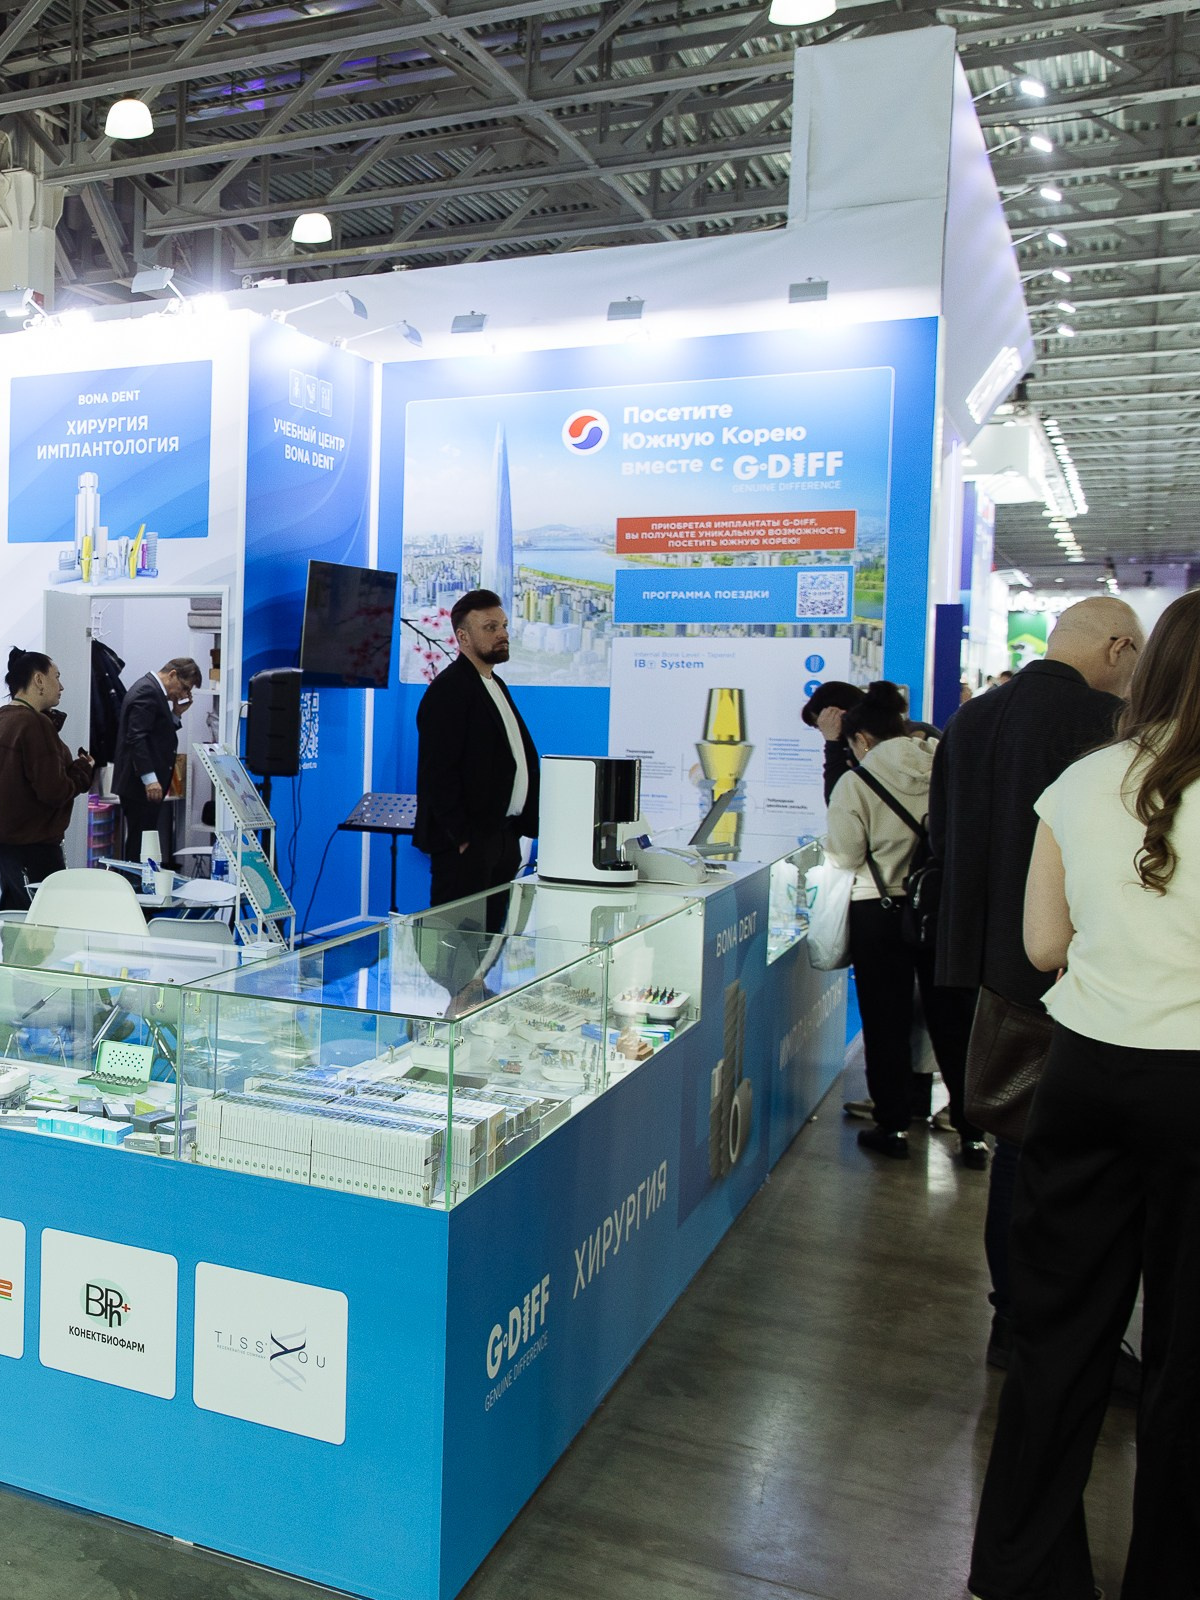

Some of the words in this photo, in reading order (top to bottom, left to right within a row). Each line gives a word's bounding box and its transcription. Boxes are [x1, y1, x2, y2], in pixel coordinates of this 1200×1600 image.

[78, 393, 109, 405] BONA
[112, 390, 140, 403] DENT
[623, 403, 733, 424] Посетите
[66, 415, 148, 436] ХИРУРГИЯ
[273, 417, 317, 444] УЧЕБНЫЙ
[318, 431, 345, 452] ЦЕНТР
[37, 436, 179, 460] ИМПЛАНТОЛОГИЯ
[622, 431, 715, 451] Южную
[722, 426, 807, 447] Корею
[284, 444, 311, 465] BONA
[312, 452, 335, 471] DENT
[621, 458, 703, 476] вместе
[710, 457, 724, 472] с
[732, 483, 776, 494] GENUINE
[778, 480, 842, 492] DIFFERENCE
[625, 532, 639, 540] ВЫ
[641, 530, 696, 540] ПОЛУЧАЕТЕ
[698, 528, 766, 539] УНИКАЛЬНУЮ
[768, 526, 847, 536] ВОЗМОЖНОСТЬ
[651, 521, 712, 531] ПРИОБРЕТАЯ
[714, 519, 780, 529] ИМПЛАНТАТЫ
[668, 539, 717, 548] ПОСЕТИТЬ
[719, 538, 760, 547] ЮЖНУЮ
[642, 590, 711, 600] ПРОГРАММА
[714, 589, 770, 600] ПОЕЗДКИ
[660, 659, 704, 670] System
[716, 926, 738, 958] BONA
[738, 910, 757, 943] DENT
[572, 1158, 668, 1300] ХИРУРГИЯ
[69, 1325, 145, 1353] КОНЕКТБИОФАРМ
[484, 1369, 513, 1412] GENUINE
[513, 1330, 549, 1381] DIFFERENCE
